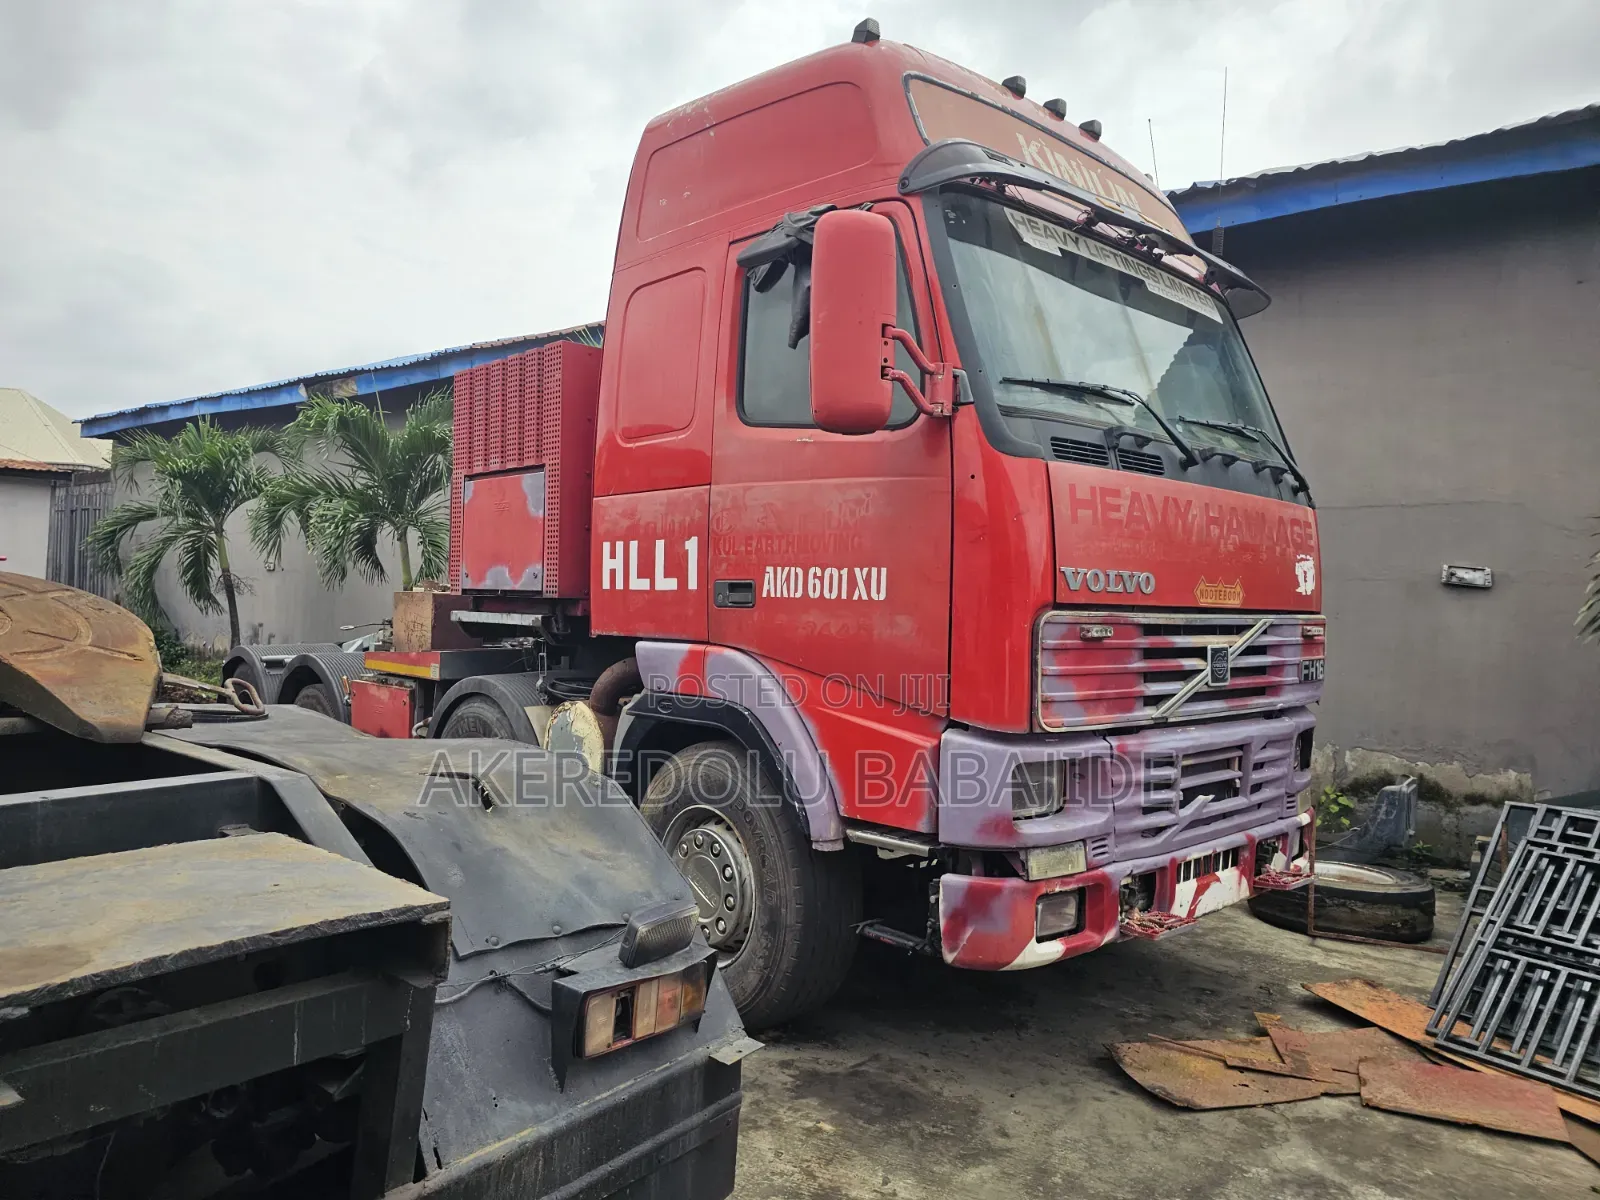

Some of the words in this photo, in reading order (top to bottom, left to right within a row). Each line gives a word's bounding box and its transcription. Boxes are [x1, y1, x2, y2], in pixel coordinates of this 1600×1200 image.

[1009, 211, 1080, 252] HEAVY
[1083, 239, 1161, 284] LIFTINGS
[1159, 272, 1214, 306] LIMITED
[1068, 483, 1193, 536] HEAVY
[602, 539, 678, 591] HLL
[684, 536, 698, 590] 1
[762, 565, 803, 598] AKD
[807, 566, 848, 600] 601
[853, 567, 887, 600] XU
[1060, 567, 1155, 594] VOLVO
[1199, 588, 1241, 602] NOOTEBOOM
